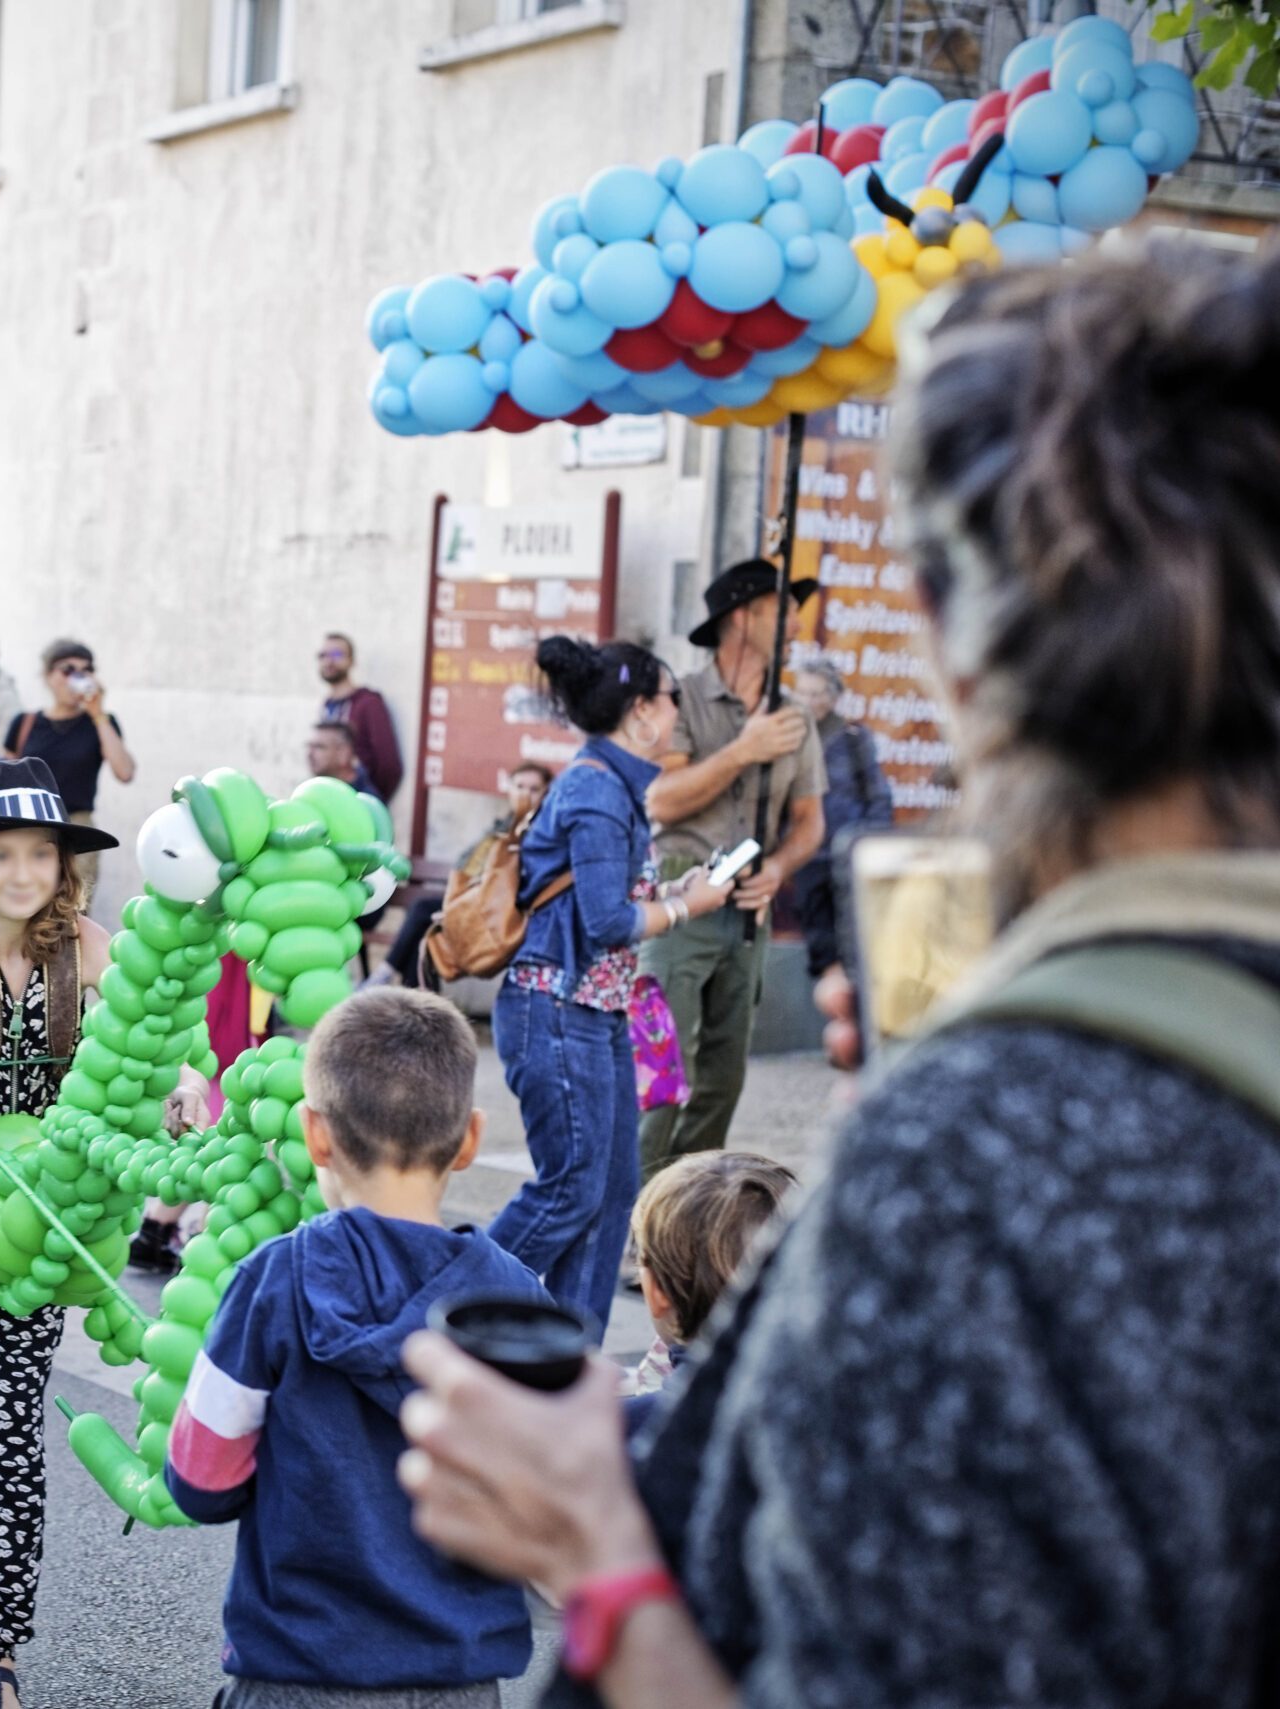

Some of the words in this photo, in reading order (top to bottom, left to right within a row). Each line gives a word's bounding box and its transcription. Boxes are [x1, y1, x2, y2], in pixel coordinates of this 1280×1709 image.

[797, 509, 878, 550] Whisky
[820, 554, 876, 588] Eaux
[825, 598, 928, 637] Spiritueu
